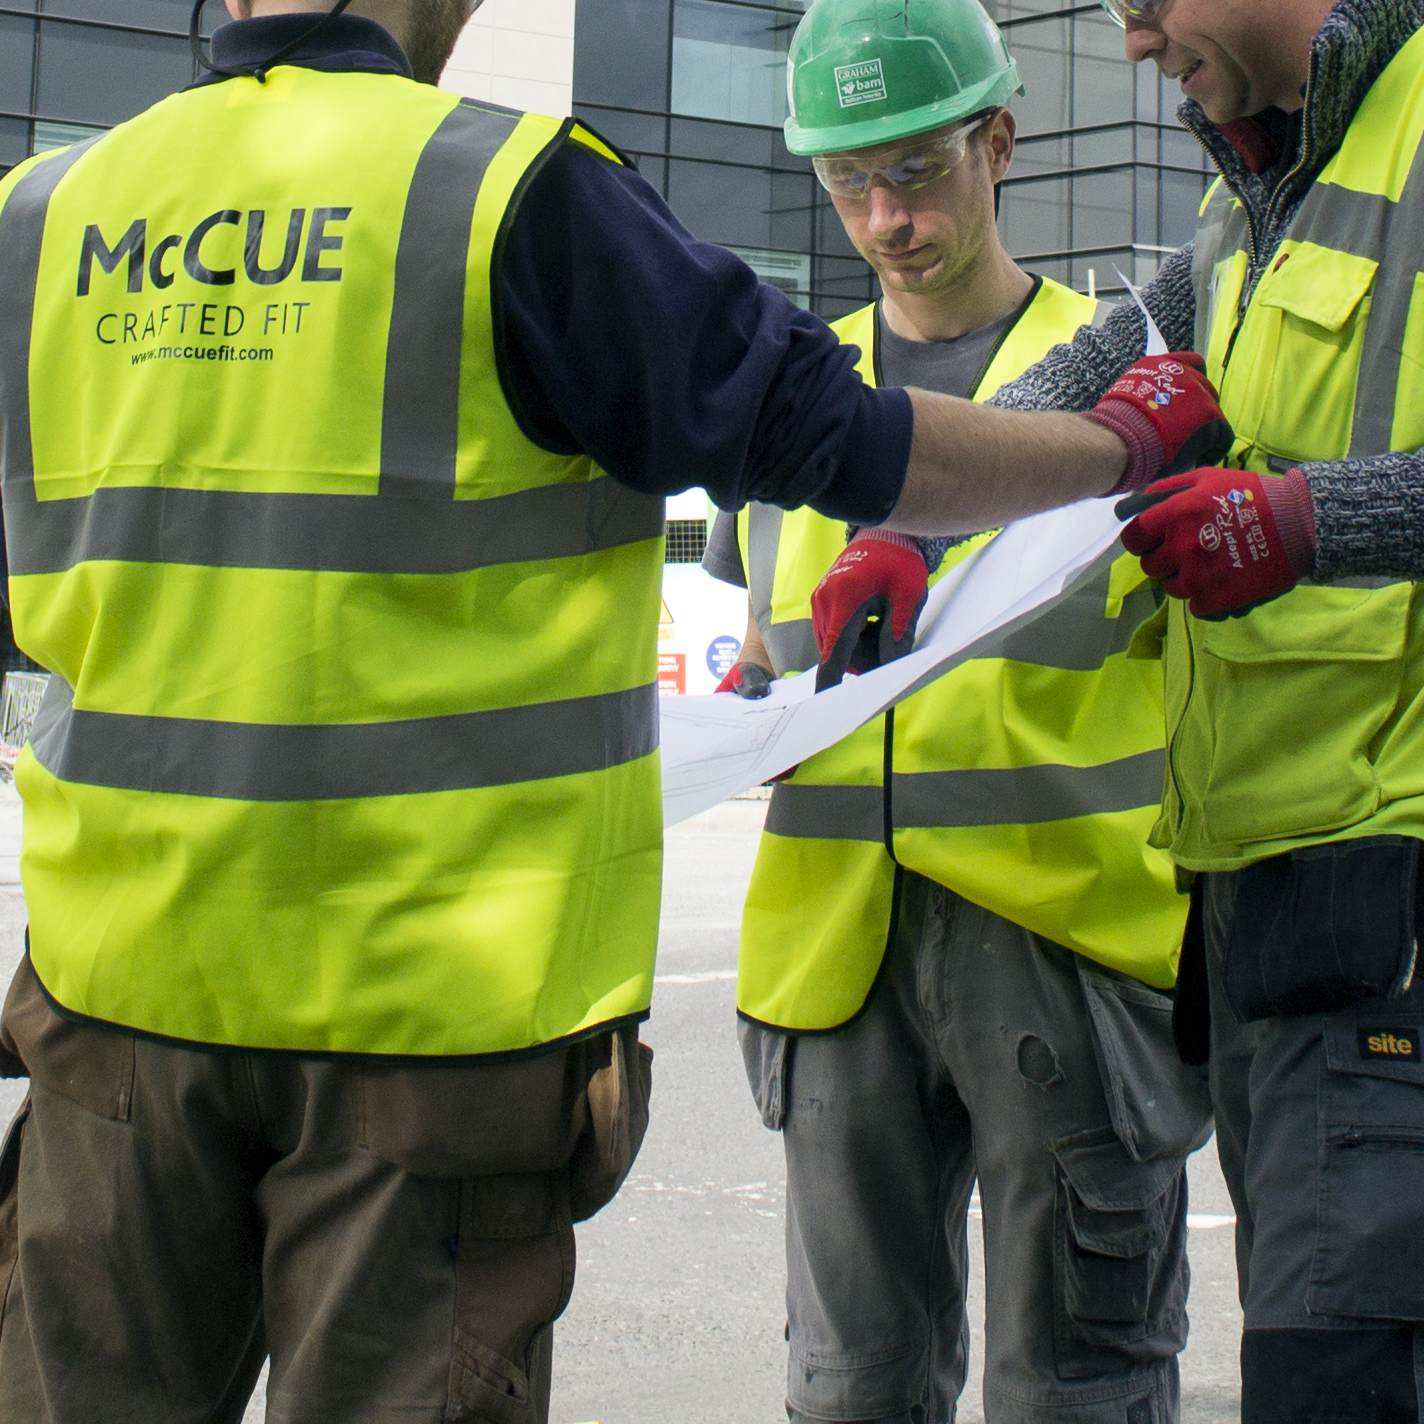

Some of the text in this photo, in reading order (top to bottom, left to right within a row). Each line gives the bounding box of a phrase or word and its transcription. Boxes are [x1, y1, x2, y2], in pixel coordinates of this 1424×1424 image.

[838, 63, 879, 81] GRAHAM
[856, 78, 882, 91] bam
[76, 206, 352, 297] McCUE
[95, 302, 311, 345] CRAFTED FIT
[131, 343, 274, 366] www.mccuefit.com
[1212, 495, 1244, 569] Adept Red
[1367, 1033, 1412, 1055] site
